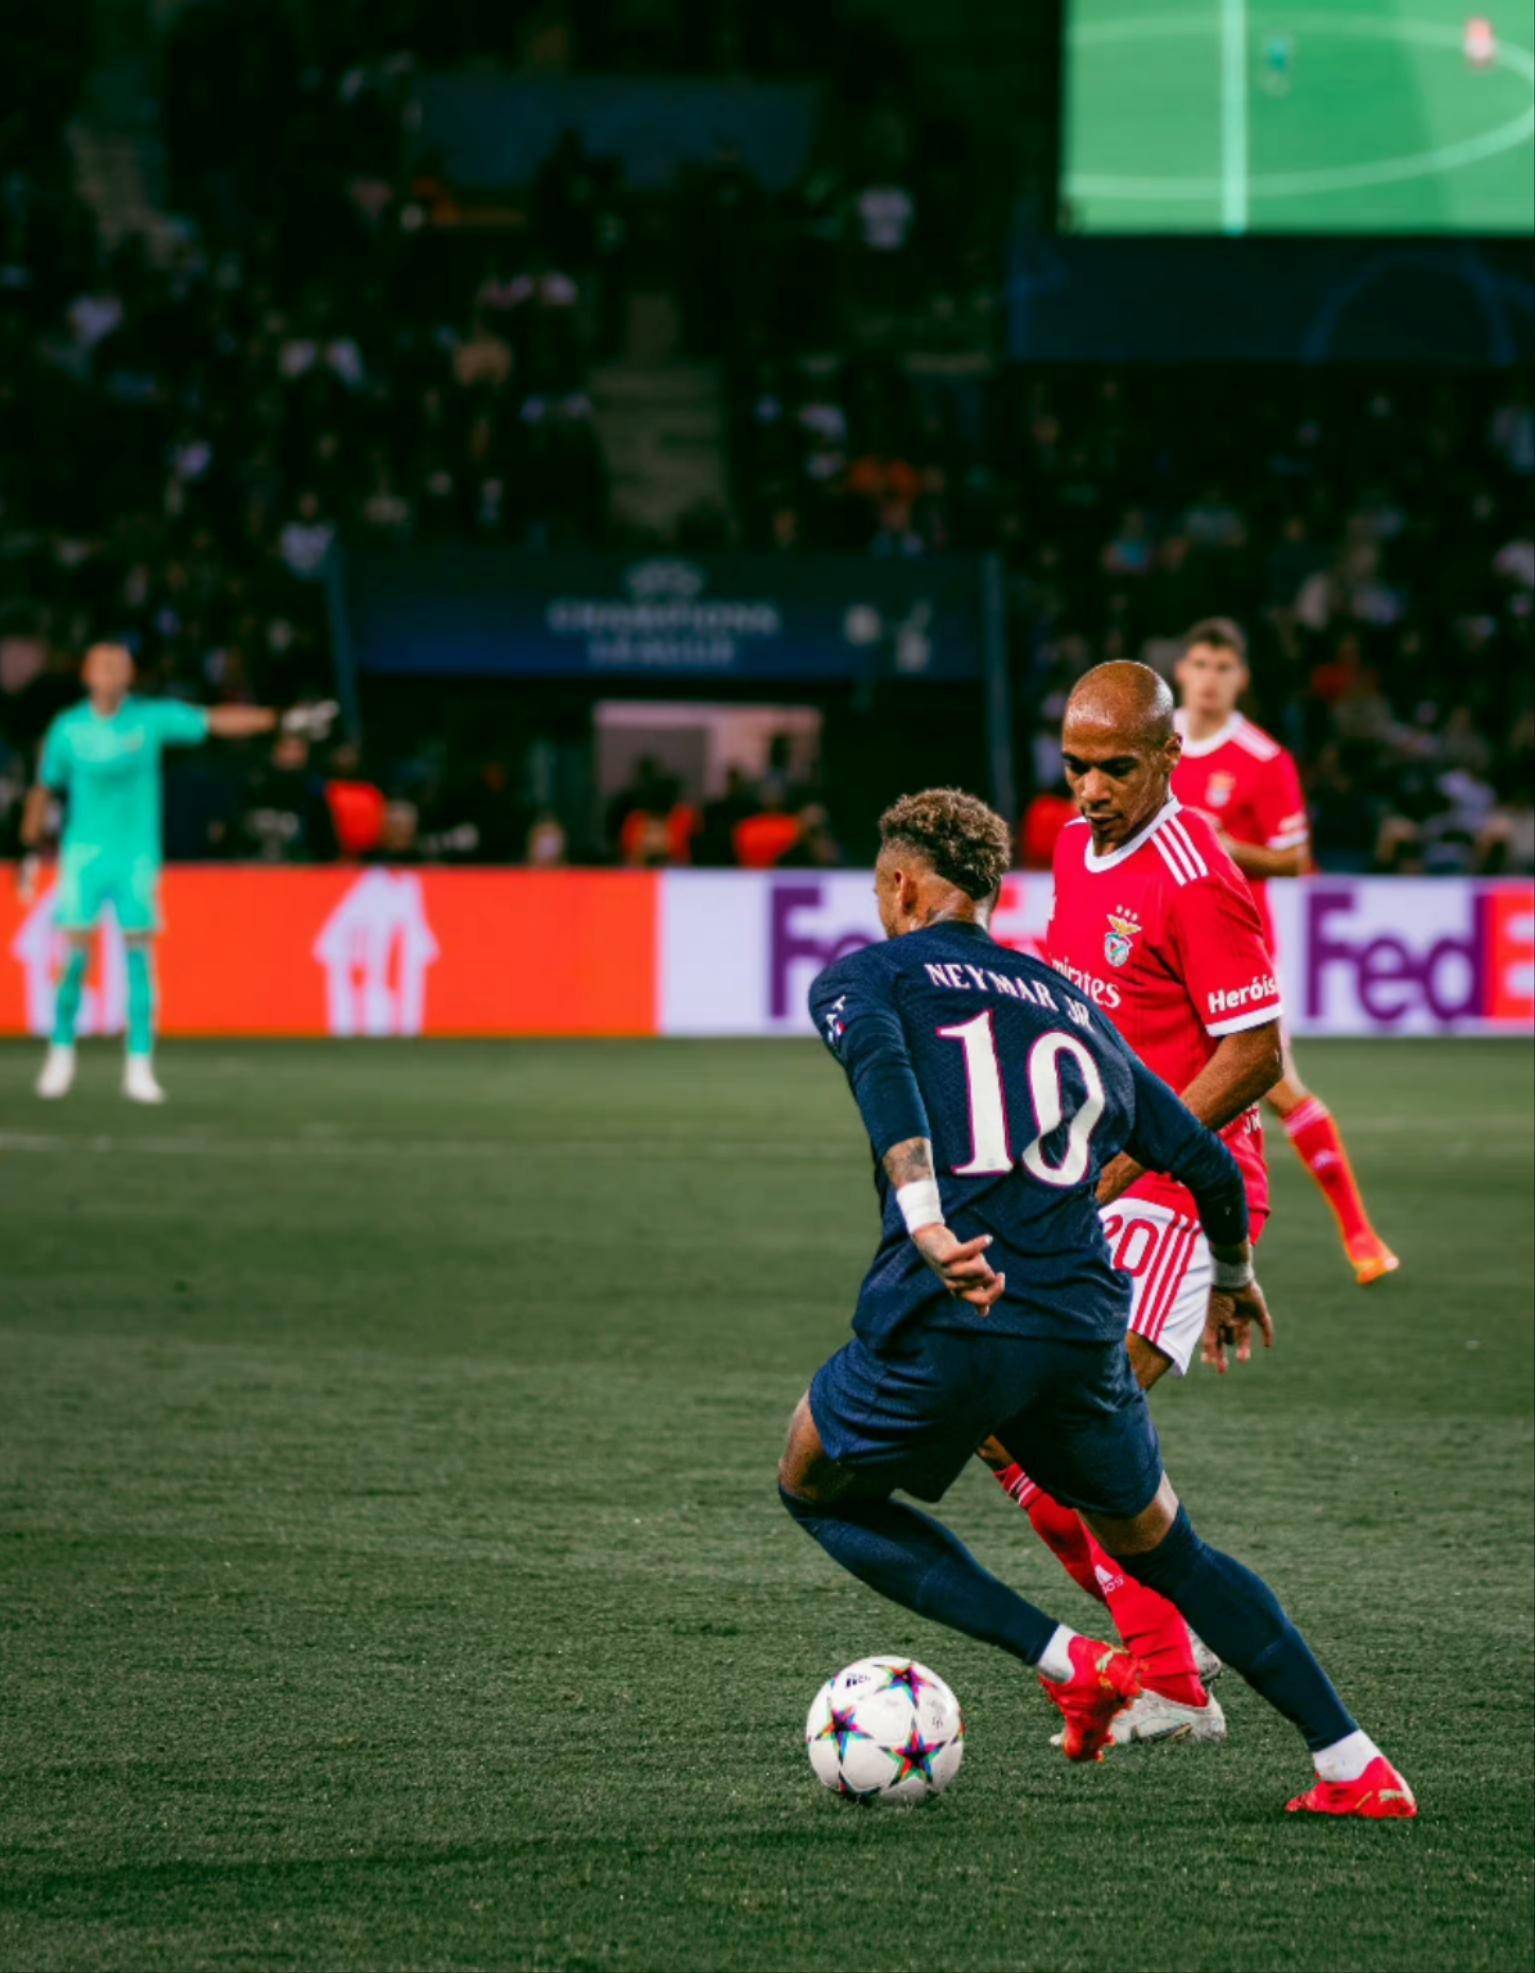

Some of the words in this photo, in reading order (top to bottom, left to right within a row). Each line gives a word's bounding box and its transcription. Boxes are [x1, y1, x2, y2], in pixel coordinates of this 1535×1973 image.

[924, 963, 1060, 1012] NEYMAR
[1051, 955, 1121, 1009] mirates
[935, 1008, 1105, 1187] 10
